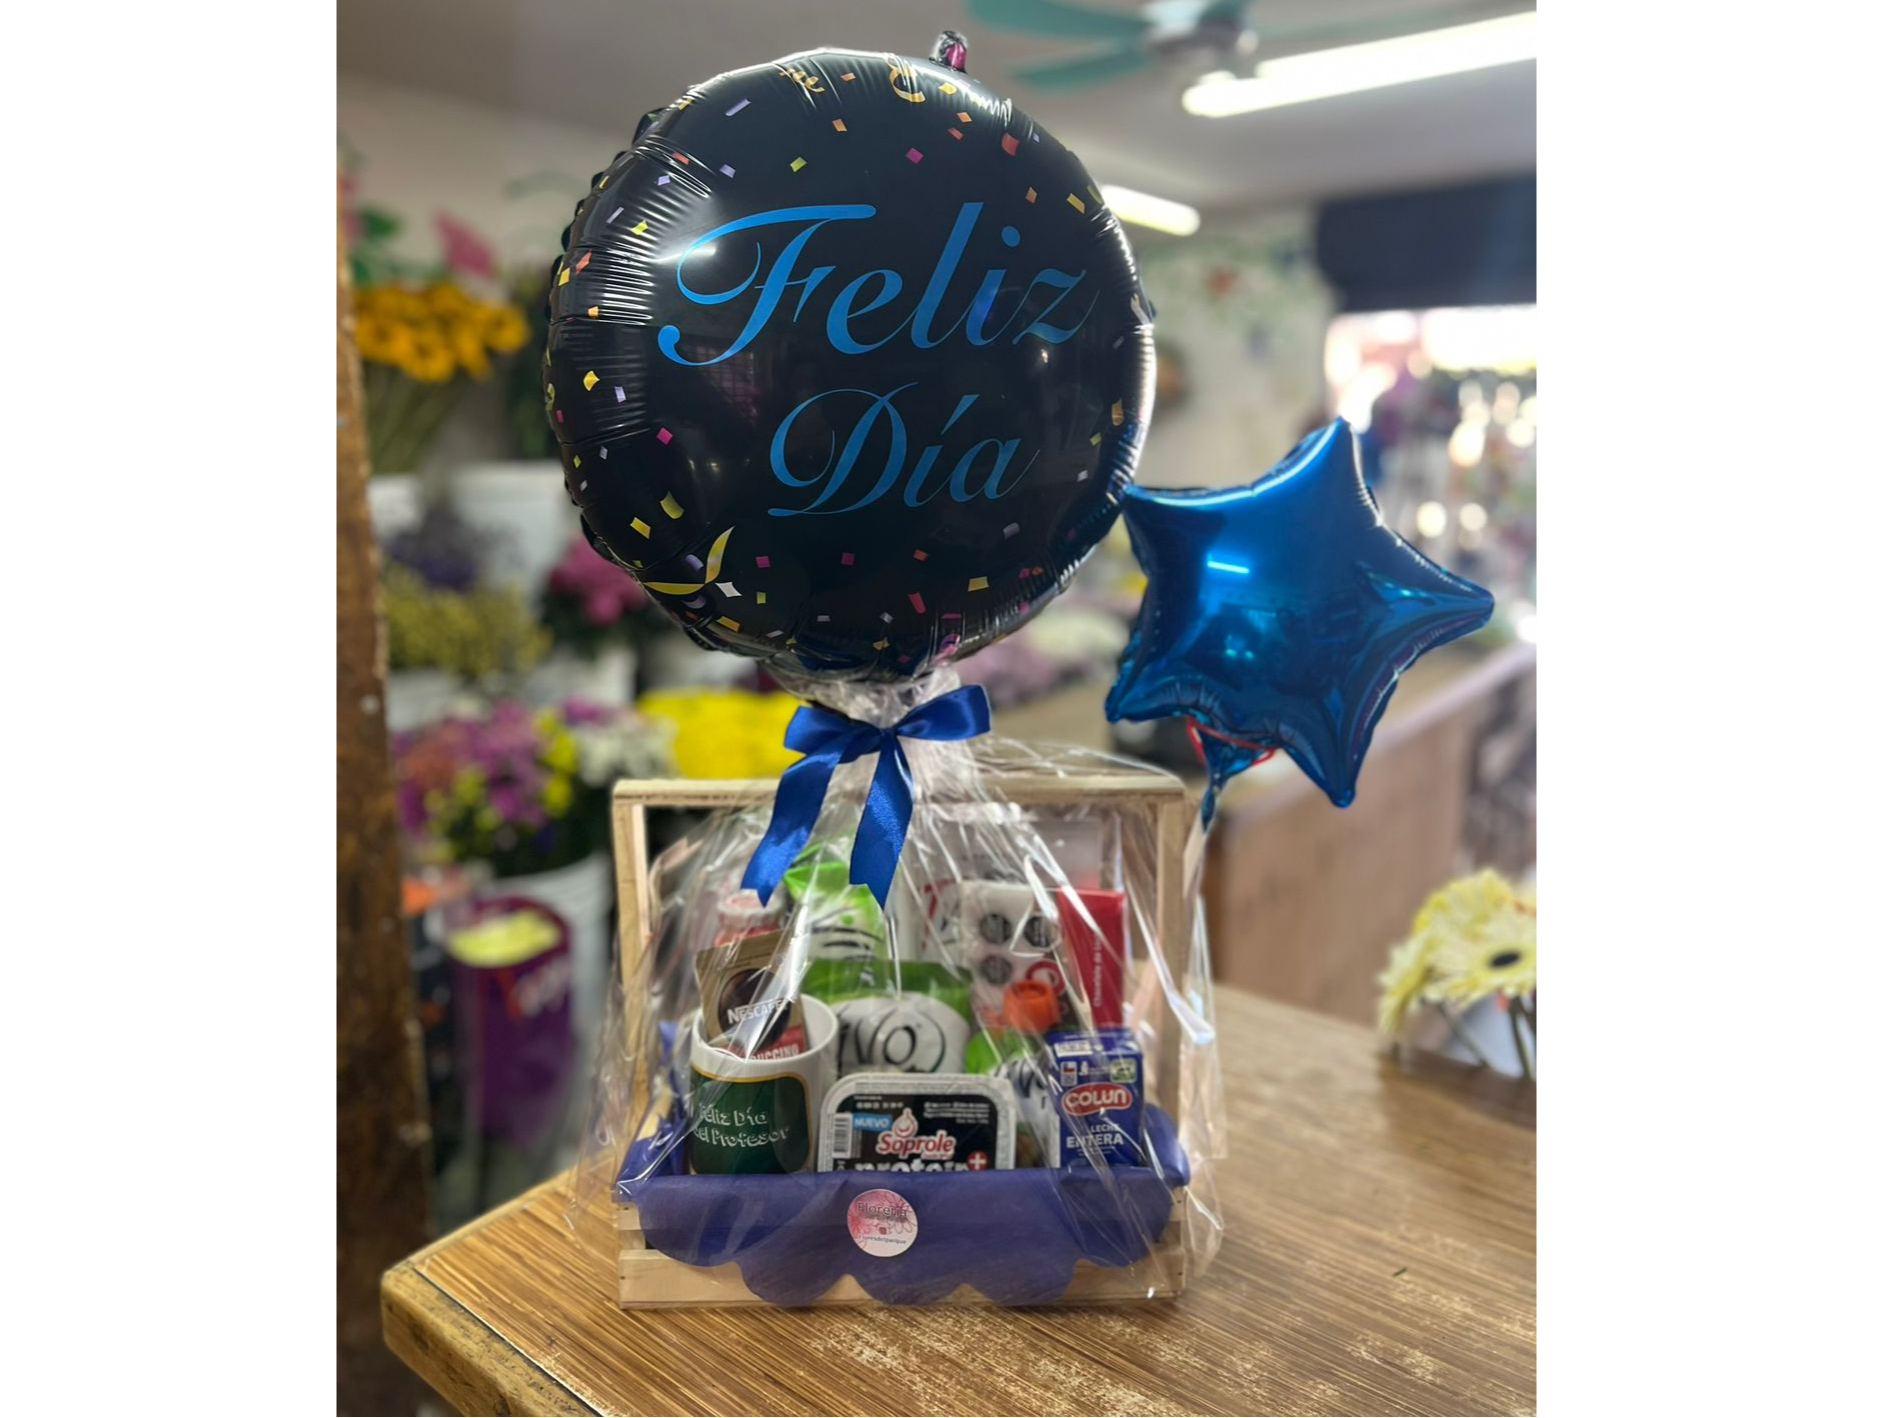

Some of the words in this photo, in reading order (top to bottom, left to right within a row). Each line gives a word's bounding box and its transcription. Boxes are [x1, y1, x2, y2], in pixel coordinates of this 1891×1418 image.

[657, 202, 1099, 367] Feliz
[768, 382, 1040, 516] Día
[1066, 1089, 1126, 1107] COLUN
[854, 1117, 890, 1128] NUEVO
[711, 1127, 790, 1148] Profesor
[878, 1131, 955, 1157] Soprole
[1066, 1133, 1124, 1148] ENTERA
